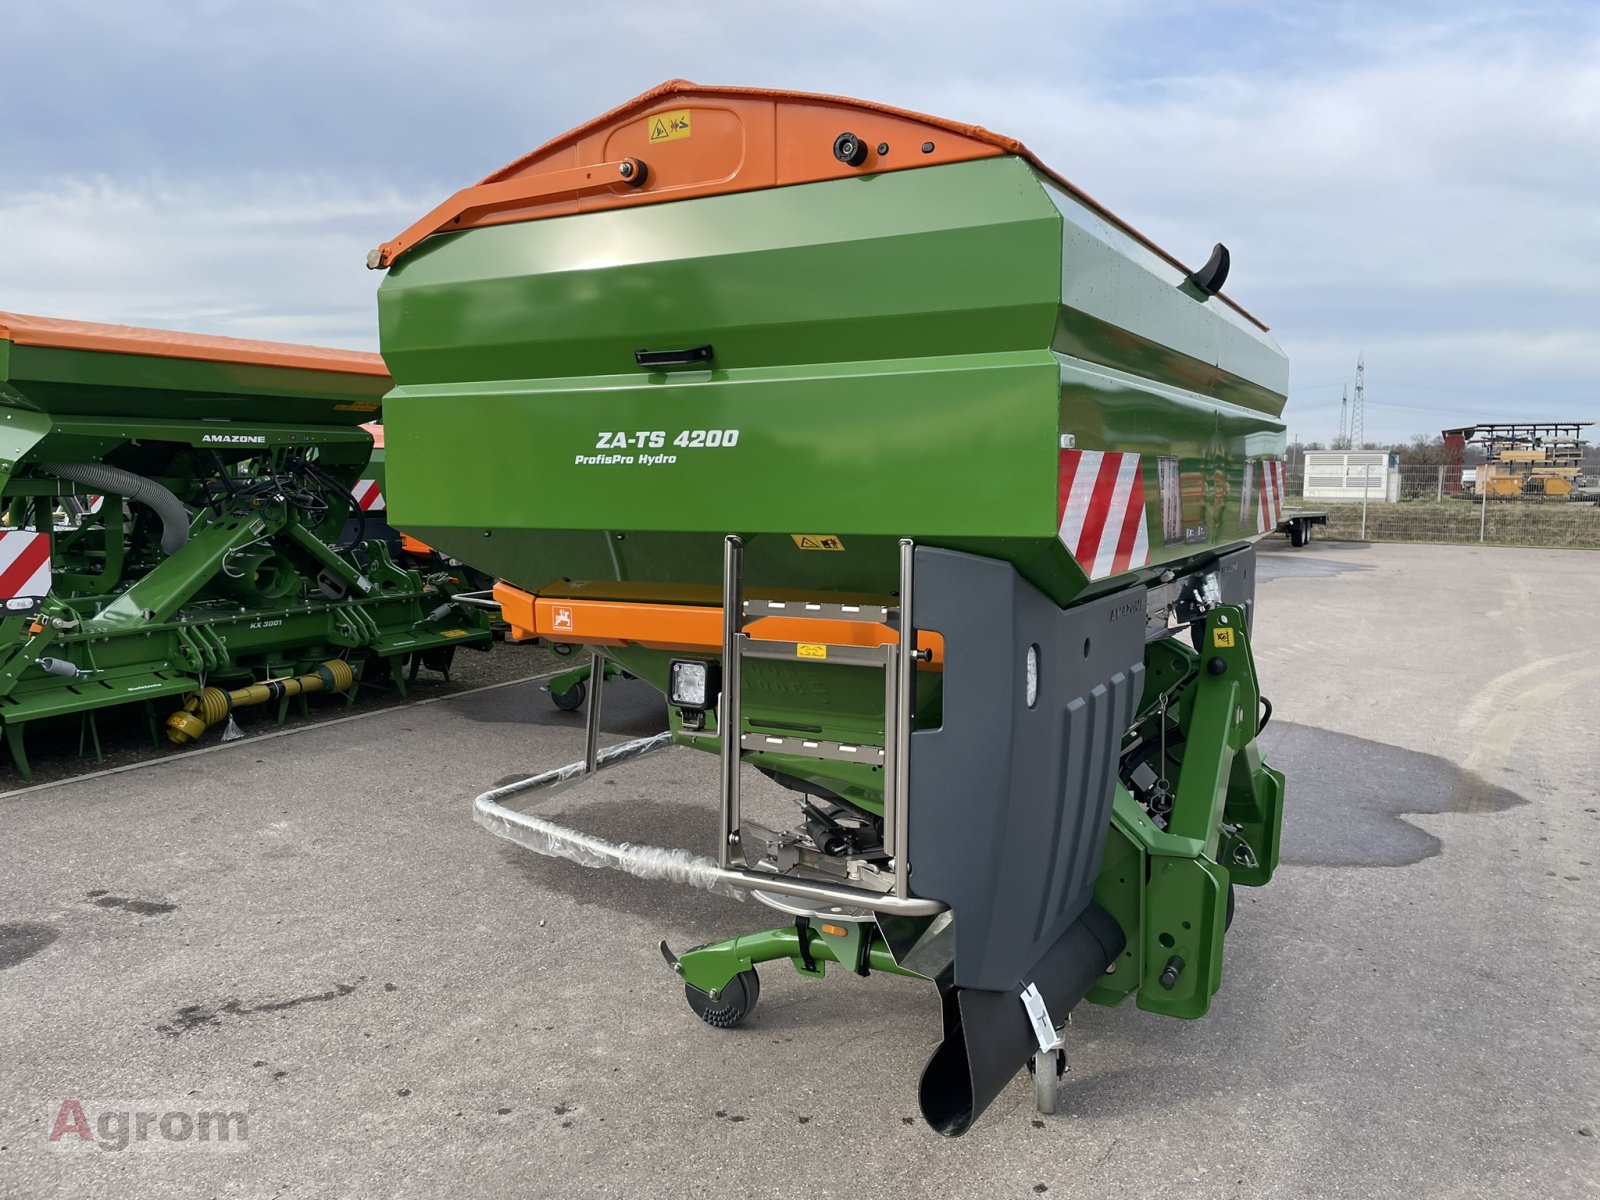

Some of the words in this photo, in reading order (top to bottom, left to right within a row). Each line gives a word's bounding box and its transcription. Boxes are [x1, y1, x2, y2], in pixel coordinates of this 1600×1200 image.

[202, 434, 266, 443] AMAZONE
[595, 431, 666, 449] ZA-TS
[673, 429, 740, 448] 4200
[574, 454, 634, 465] ProfisPro
[638, 453, 677, 466] Hydro
[262, 619, 283, 628] 3001
